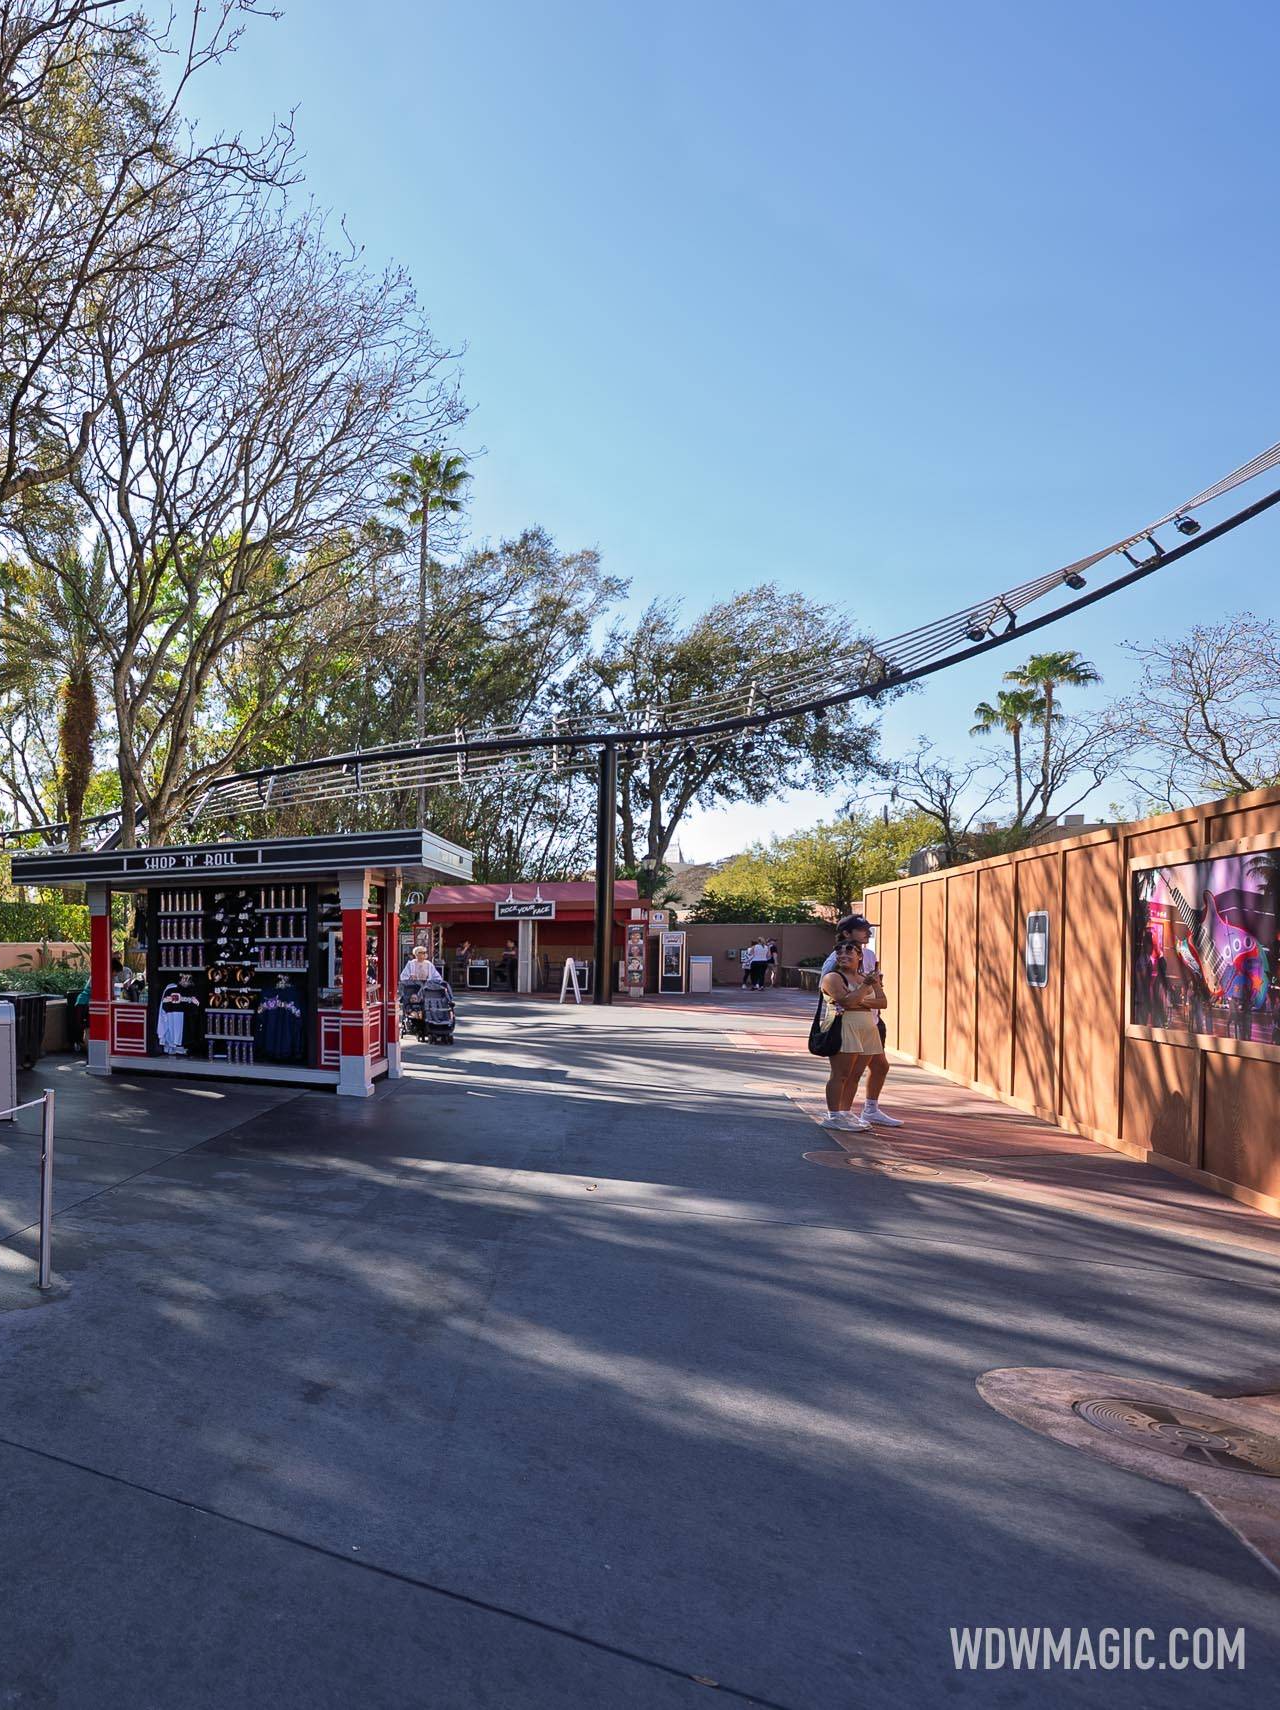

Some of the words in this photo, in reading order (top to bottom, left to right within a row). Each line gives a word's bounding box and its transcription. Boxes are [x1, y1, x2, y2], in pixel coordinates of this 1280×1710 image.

[144, 856, 176, 869] SHOP
[203, 853, 237, 866] ROLL
[500, 905, 518, 914] ROCK
[518, 905, 535, 914] YOUR
